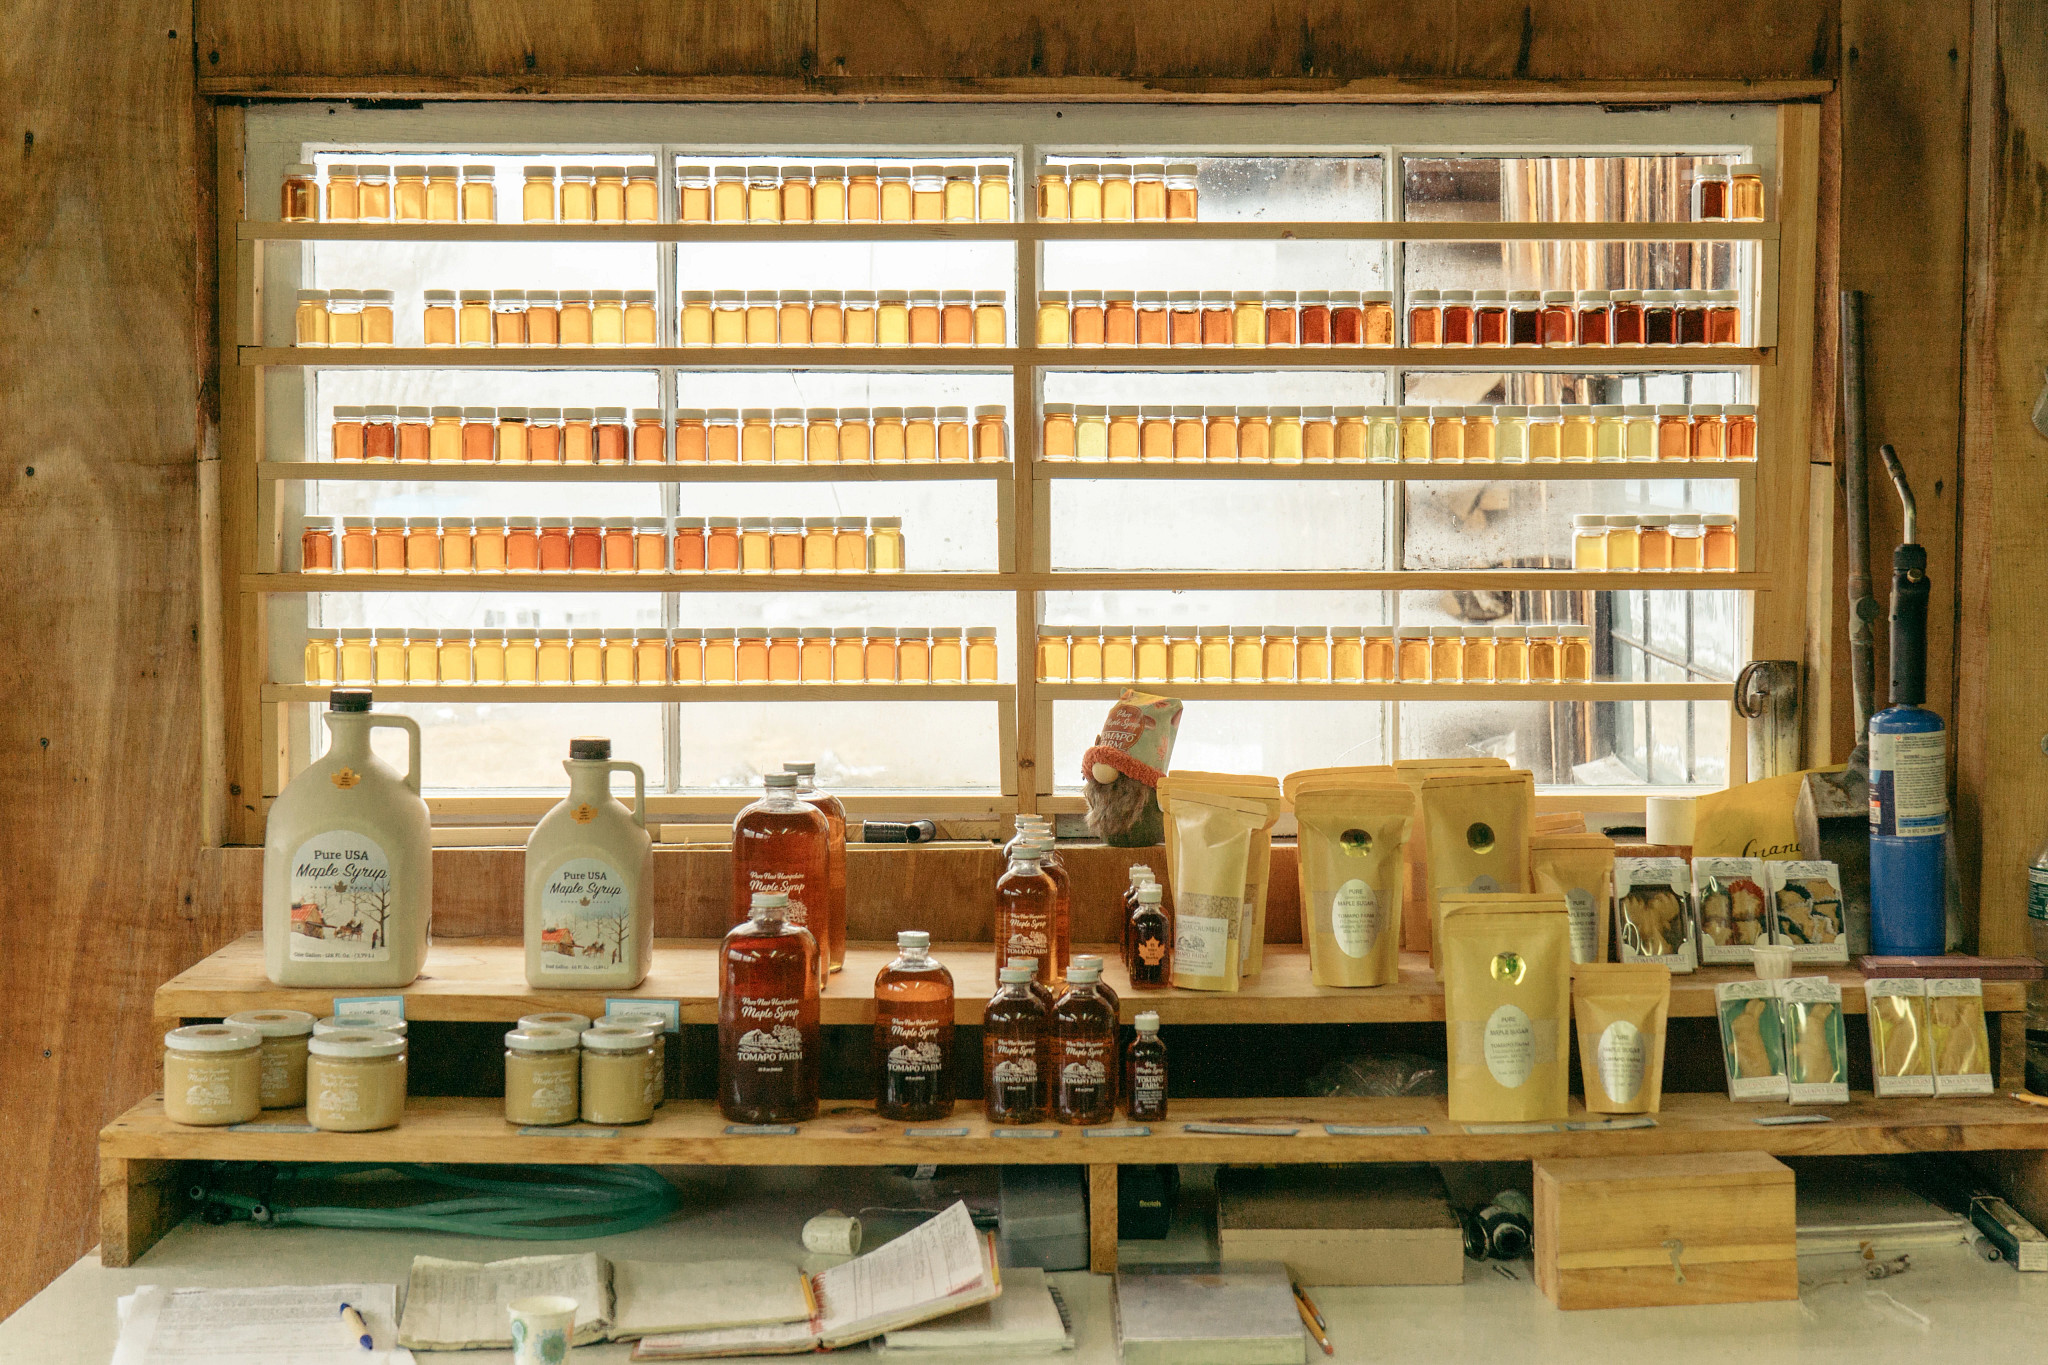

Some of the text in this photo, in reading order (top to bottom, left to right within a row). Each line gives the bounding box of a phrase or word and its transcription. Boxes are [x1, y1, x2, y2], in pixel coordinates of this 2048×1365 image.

[314, 850, 369, 860] Pure USA
[295, 863, 387, 883] Maple Syrup
[564, 872, 607, 880] Pure USA
[549, 882, 622, 899] Maple Syrup
[749, 880, 805, 895] Maple Syrup
[1010, 919, 1047, 930] Maple Syrup
[741, 1006, 799, 1022] Maple Syrup
[891, 1025, 940, 1040] Maple Syrup
[737, 1052, 803, 1061] TOMAPO FARM
[998, 1045, 1036, 1057] Maple Syrup
[1066, 1046, 1104, 1059] Maple Syrup
[888, 1063, 942, 1072] TOMAPO FARM
[1062, 1077, 1089, 1085] TOMAPO
[1136, 1075, 1164, 1083] TOMAPO
